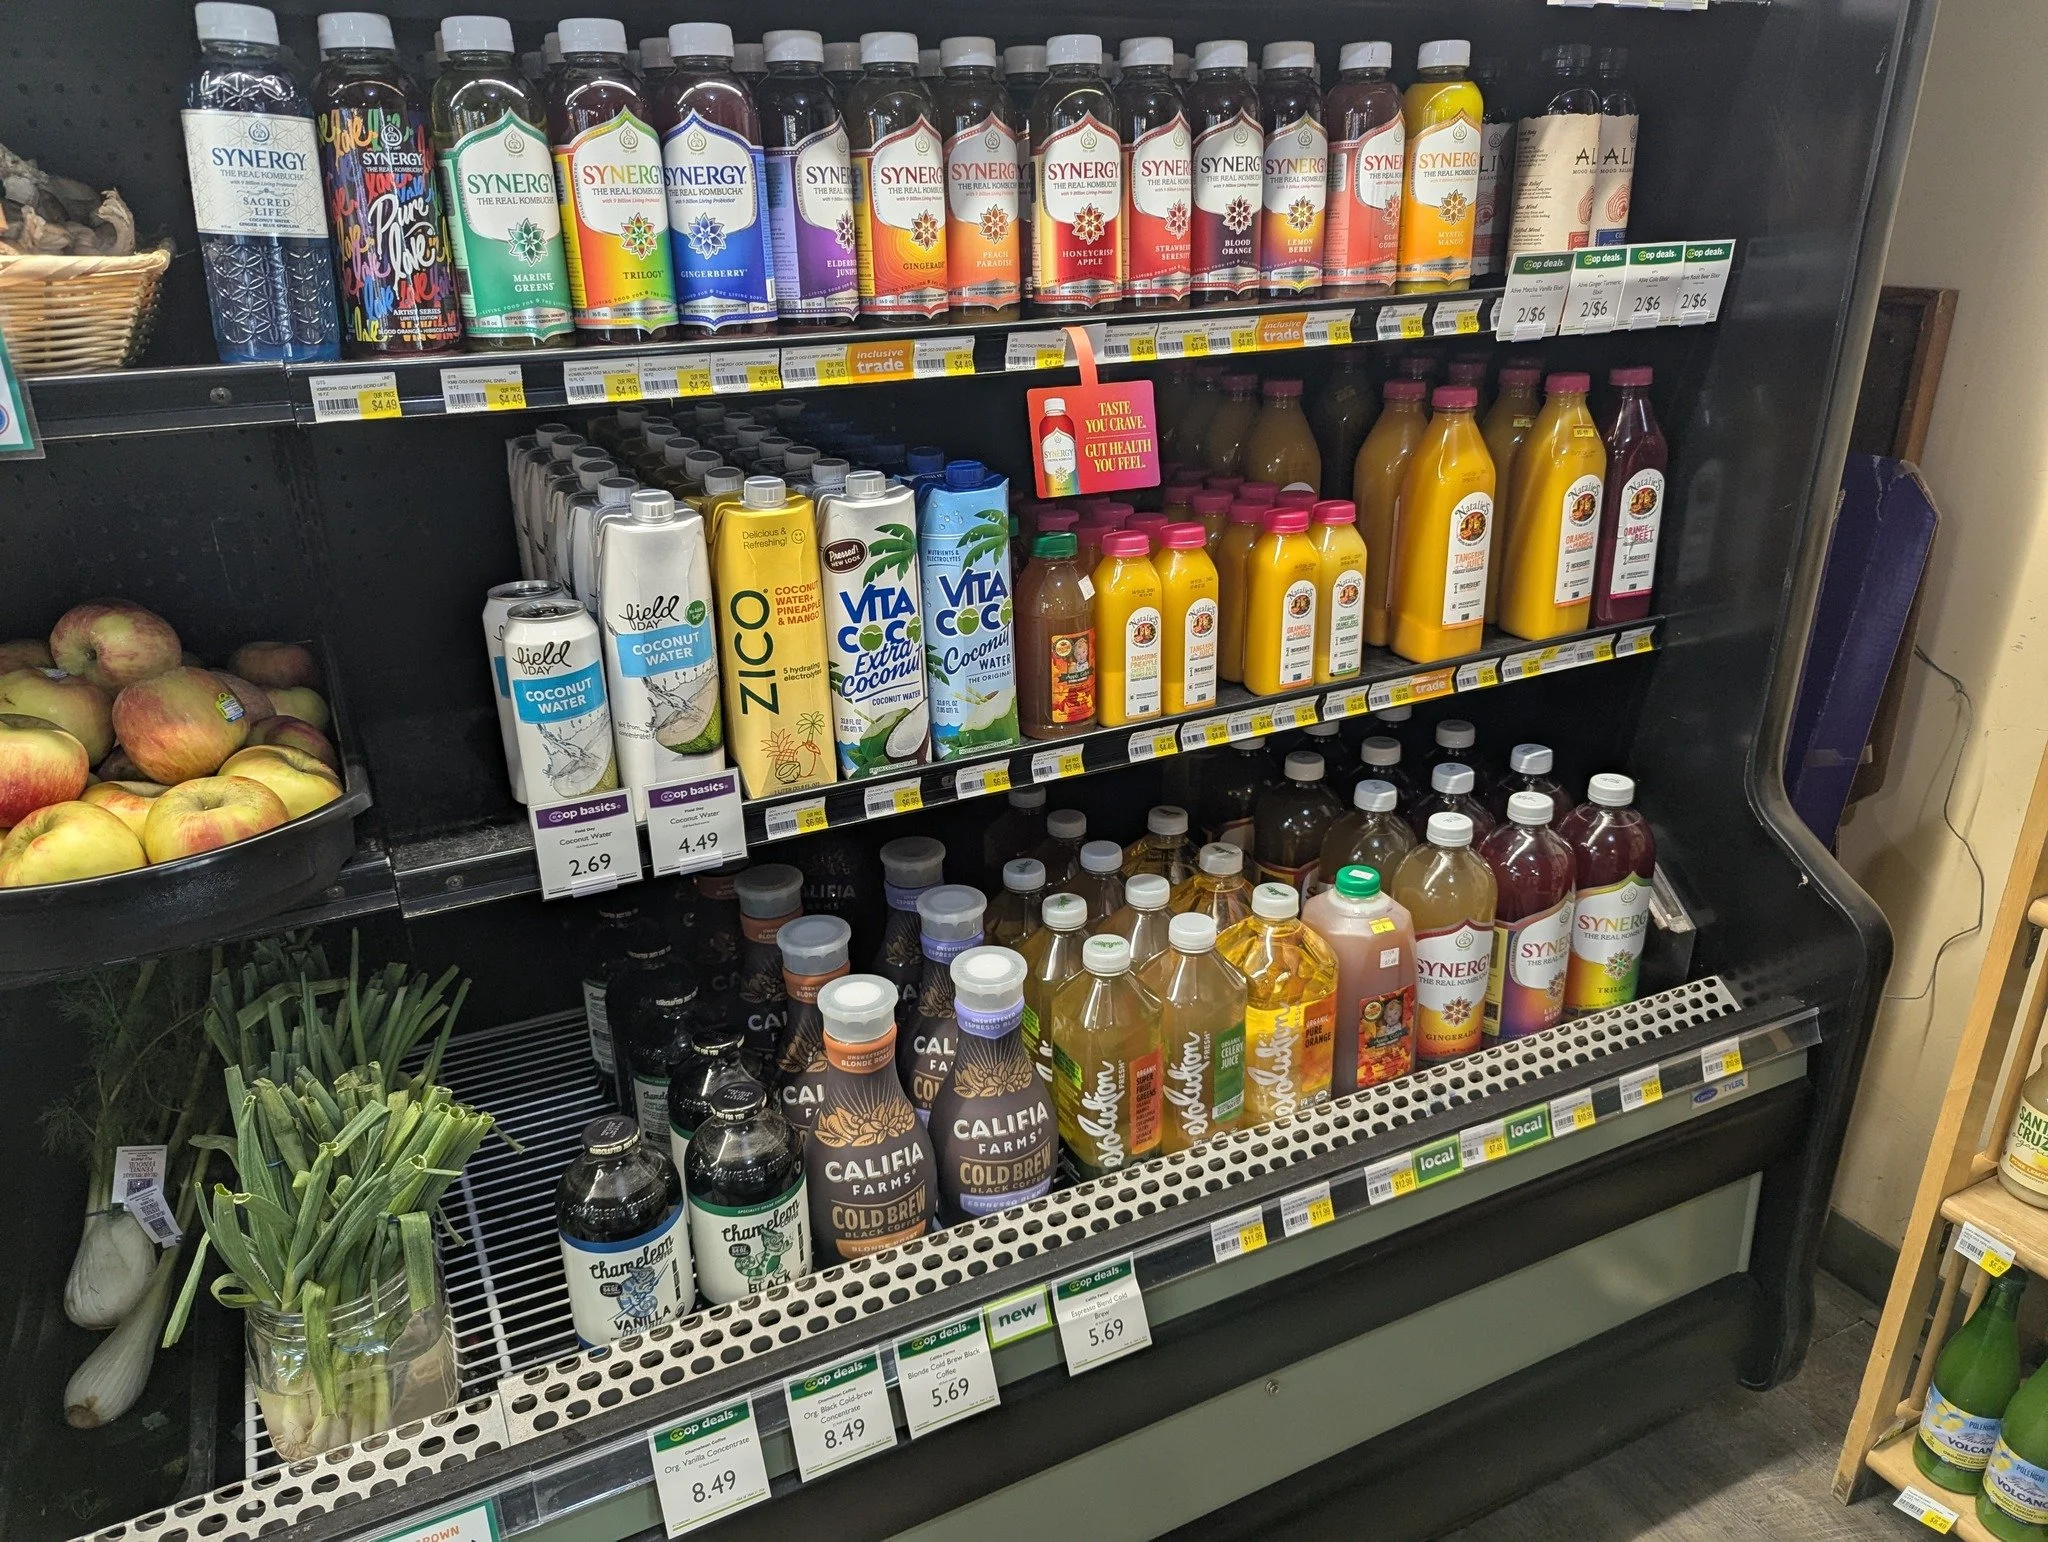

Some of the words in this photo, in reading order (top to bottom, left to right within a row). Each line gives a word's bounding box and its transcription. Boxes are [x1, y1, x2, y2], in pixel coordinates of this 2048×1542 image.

[212, 148, 307, 171] SYNERGY
[362, 152, 423, 166] SYNERGY
[220, 169, 237, 177] THE
[238, 170, 260, 179] REAL
[243, 197, 290, 208] SACRED
[254, 208, 282, 218] LIFE
[1225, 239, 1250, 247] BLOOD
[1287, 238, 1313, 246] LEMON
[1438, 238, 1464, 246] MANGO
[983, 251, 1009, 259] PEACH
[1062, 249, 1113, 258] HONEYCRISP
[1222, 247, 1252, 255] ORANGE
[1602, 254, 1620, 263] deals
[1656, 250, 1674, 259] deals
[1704, 248, 1723, 257] deals
[1077, 258, 1103, 266] APPLE
[1543, 259, 1564, 267] deals
[512, 273, 552, 282] MARINE
[623, 271, 664, 279] TRILOGY
[681, 269, 748, 278] GINGERBERRY
[514, 282, 554, 292] GREENS
[1634, 297, 1660, 312] 2/$6
[1681, 293, 1707, 309] 2/$6
[1517, 306, 1546, 323] 2/$6
[1580, 301, 1608, 317] 2/$6
[1263, 329, 1300, 342] trade
[856, 348, 903, 359] inclusive
[856, 359, 905, 374] trade
[616, 385, 638, 396] $4.19
[689, 381, 711, 392] $4.29
[372, 401, 397, 412] $4.49
[500, 395, 523, 405] $4.49
[1098, 401, 1131, 416] TASTE
[1085, 419, 1108, 433] YOU
[1110, 416, 1147, 430] CRAVE.
[1085, 443, 1108, 457] GUT
[1110, 439, 1151, 455] HEALTH
[1094, 458, 1116, 472] YOU
[1118, 456, 1146, 470] FEEL.
[742, 528, 779, 540] Delicious
[744, 537, 788, 550] Refreshing!
[775, 580, 819, 596] COCONUT
[938, 568, 1009, 609] VITA
[777, 600, 821, 616] PINEAPPLE
[839, 583, 916, 624] VITA
[619, 595, 680, 630] field
[787, 612, 820, 625] MANGO
[637, 620, 660, 630] DAY
[632, 631, 699, 655] COCONUT
[513, 641, 571, 675] field
[646, 648, 693, 666] WATER
[730, 589, 780, 715] ZICO
[790, 661, 820, 674] hydrating
[979, 654, 1011, 670] WATER
[529, 665, 551, 675] DAY
[525, 677, 592, 702] COCONUT
[1415, 680, 1445, 694] trade
[538, 696, 587, 715] WATER
[872, 694, 901, 706] COCONUT
[902, 690, 921, 702] WATER
[670, 815, 698, 825] Coconut
[699, 810, 720, 820] Water
[805, 816, 824, 828] $6.99
[560, 836, 588, 846] Coconut
[590, 830, 612, 841] Water
[679, 832, 718, 854] 4.49
[569, 853, 611, 877] 2.69
[1435, 978, 1456, 986] REAL
[1305, 1025, 1323, 1038] PURE
[1221, 1036, 1241, 1049] ORGANIC
[1305, 1031, 1331, 1048] ORANGE
[1221, 1042, 1244, 1058] CELERY
[841, 1058, 873, 1068] BLONDE
[1221, 1055, 1239, 1070] JUICE
[1725, 1058, 1740, 1068] $10.99
[1136, 1073, 1154, 1085] SUPER
[1722, 1079, 1745, 1092] TYLER
[1136, 1082, 1152, 1094] FRUIT
[1645, 1087, 1659, 1098] $10.99
[1136, 1090, 1157, 1103] GREENS
[953, 1101, 1050, 1141] CALIFIA
[1577, 1111, 1593, 1123] $10.99
[1510, 1116, 1542, 1139] local
[978, 1132, 1038, 1156] FARMS
[825, 1141, 924, 1183] CALIFIA
[959, 1159, 1010, 1186] COLD
[1012, 1142, 1051, 1179] BREW
[1420, 1147, 1454, 1171] local
[852, 1172, 912, 1196] FARMS
[970, 1183, 1010, 1194] BLACK
[1395, 1177, 1413, 1191] $12.99
[832, 1205, 885, 1231] COLD
[887, 1186, 926, 1224] BREW
[1312, 1207, 1331, 1221] $11.99
[722, 1200, 800, 1243] Chameleon
[845, 1227, 883, 1239] BLACK
[1244, 1232, 1263, 1246] $11.99
[589, 1235, 674, 1280] Chameleon
[1094, 1266, 1119, 1282] deals
[748, 1272, 792, 1294] BLACK
[1071, 1305, 1096, 1318] Espresso
[1097, 1298, 1114, 1308] Blend
[1114, 1293, 1127, 1302] Cold
[613, 1306, 671, 1332] VANILLA
[999, 1303, 1037, 1327] new
[1094, 1310, 1110, 1320] Brew
[939, 1323, 967, 1337] deals
[1089, 1319, 1123, 1347] 5.69
[834, 1362, 863, 1379] deals
[907, 1366, 929, 1380] Blonde
[930, 1360, 946, 1371] Cold
[947, 1355, 963, 1365] Brew
[964, 1348, 980, 1359] Black
[936, 1368, 956, 1379] Coffee
[932, 1378, 969, 1407] 5.69
[804, 1410, 819, 1420] Org.
[821, 1402, 838, 1413] Black
[839, 1390, 873, 1406] Cold-brew
[702, 1410, 734, 1428] deals
[821, 1405, 861, 1424] Concentrate
[825, 1419, 865, 1449] 8.49
[665, 1464, 682, 1474] Org.
[682, 1454, 705, 1467] Vanilla
[707, 1437, 750, 1458] Concentrate
[2016, 1464, 2045, 1482] POLENGHI
[692, 1470, 736, 1503] 8.49
